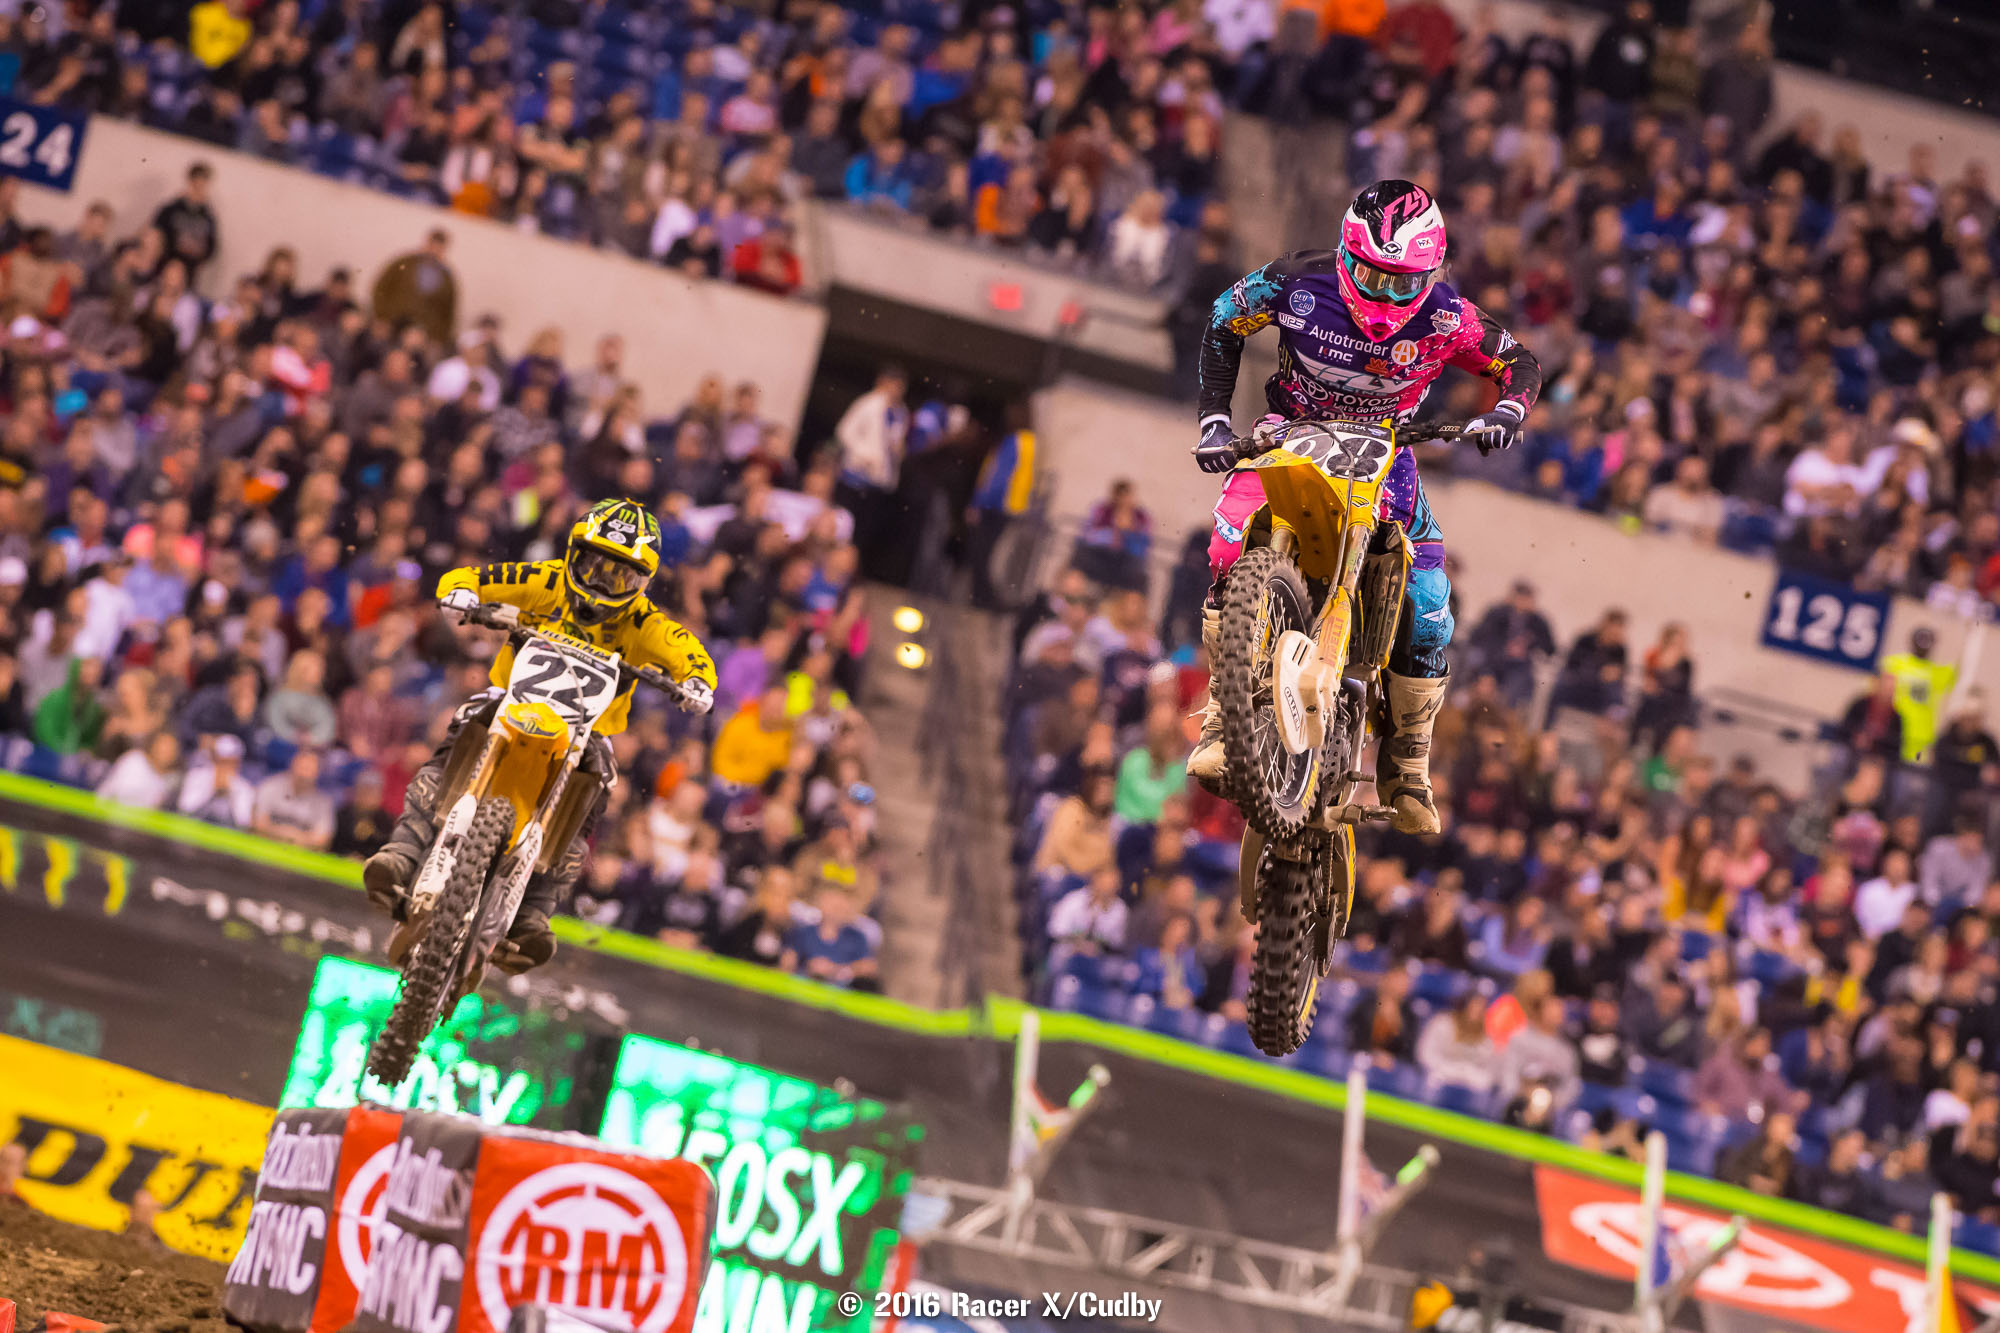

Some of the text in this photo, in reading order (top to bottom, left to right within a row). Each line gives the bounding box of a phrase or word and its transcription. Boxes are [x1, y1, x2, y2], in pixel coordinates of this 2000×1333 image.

[0, 111, 75, 177] 24
[1437, 309, 1460, 324] AMA
[1308, 325, 1389, 357] Autotrader
[1330, 391, 1400, 407] TOYOTA
[1768, 586, 1881, 659] 125
[512, 654, 607, 716] 22
